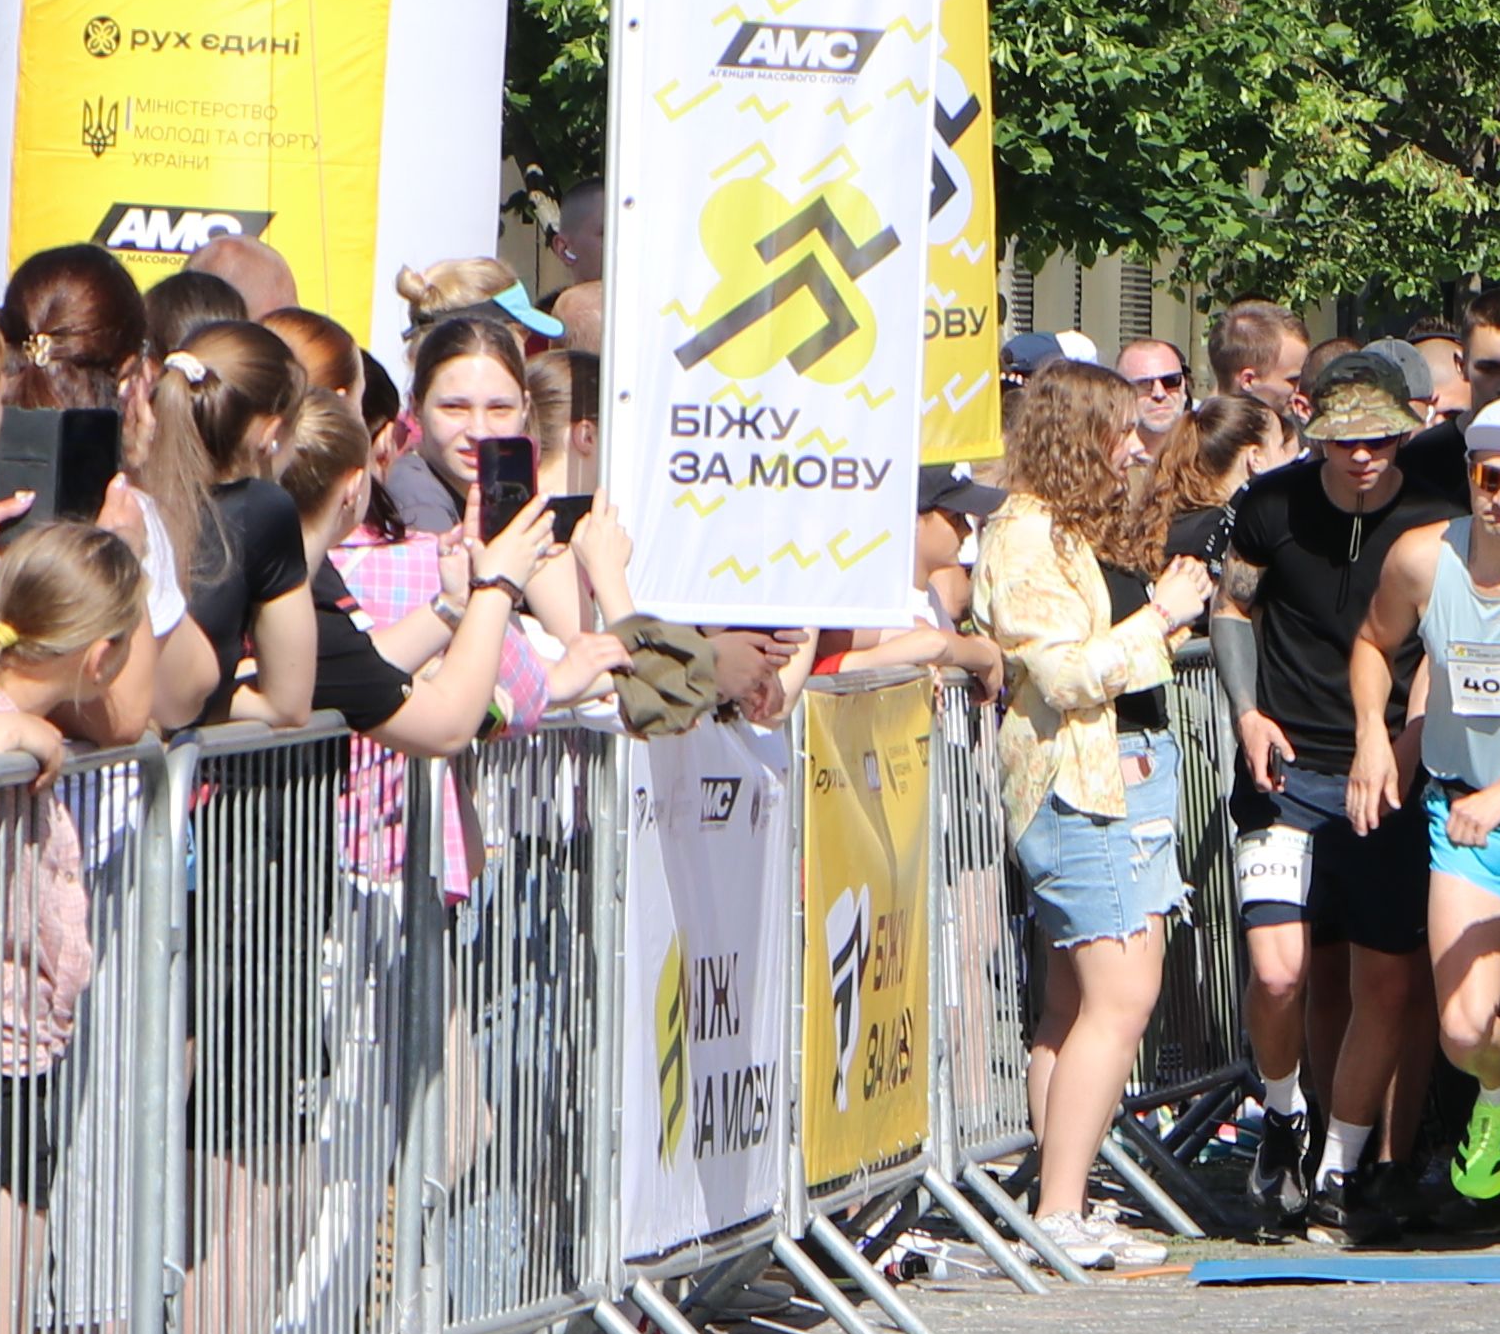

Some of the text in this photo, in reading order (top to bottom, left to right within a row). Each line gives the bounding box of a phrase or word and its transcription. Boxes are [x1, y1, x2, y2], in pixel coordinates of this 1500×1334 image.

[130, 27, 299, 56] рух єдині
[135, 97, 277, 121] МІНІСТЕРСТВО
[133, 125, 320, 150] МОЛОДІ ТА СПОРТУ
[132, 151, 210, 172] УКРАЇНИ
[923, 306, 988, 339] ОВУ
[669, 404, 800, 441] БІЖУ
[668, 453, 892, 491] ЗА МОВУ
[694, 952, 740, 1043] ІЖУ
[721, 1061, 777, 1156] МОВУ
